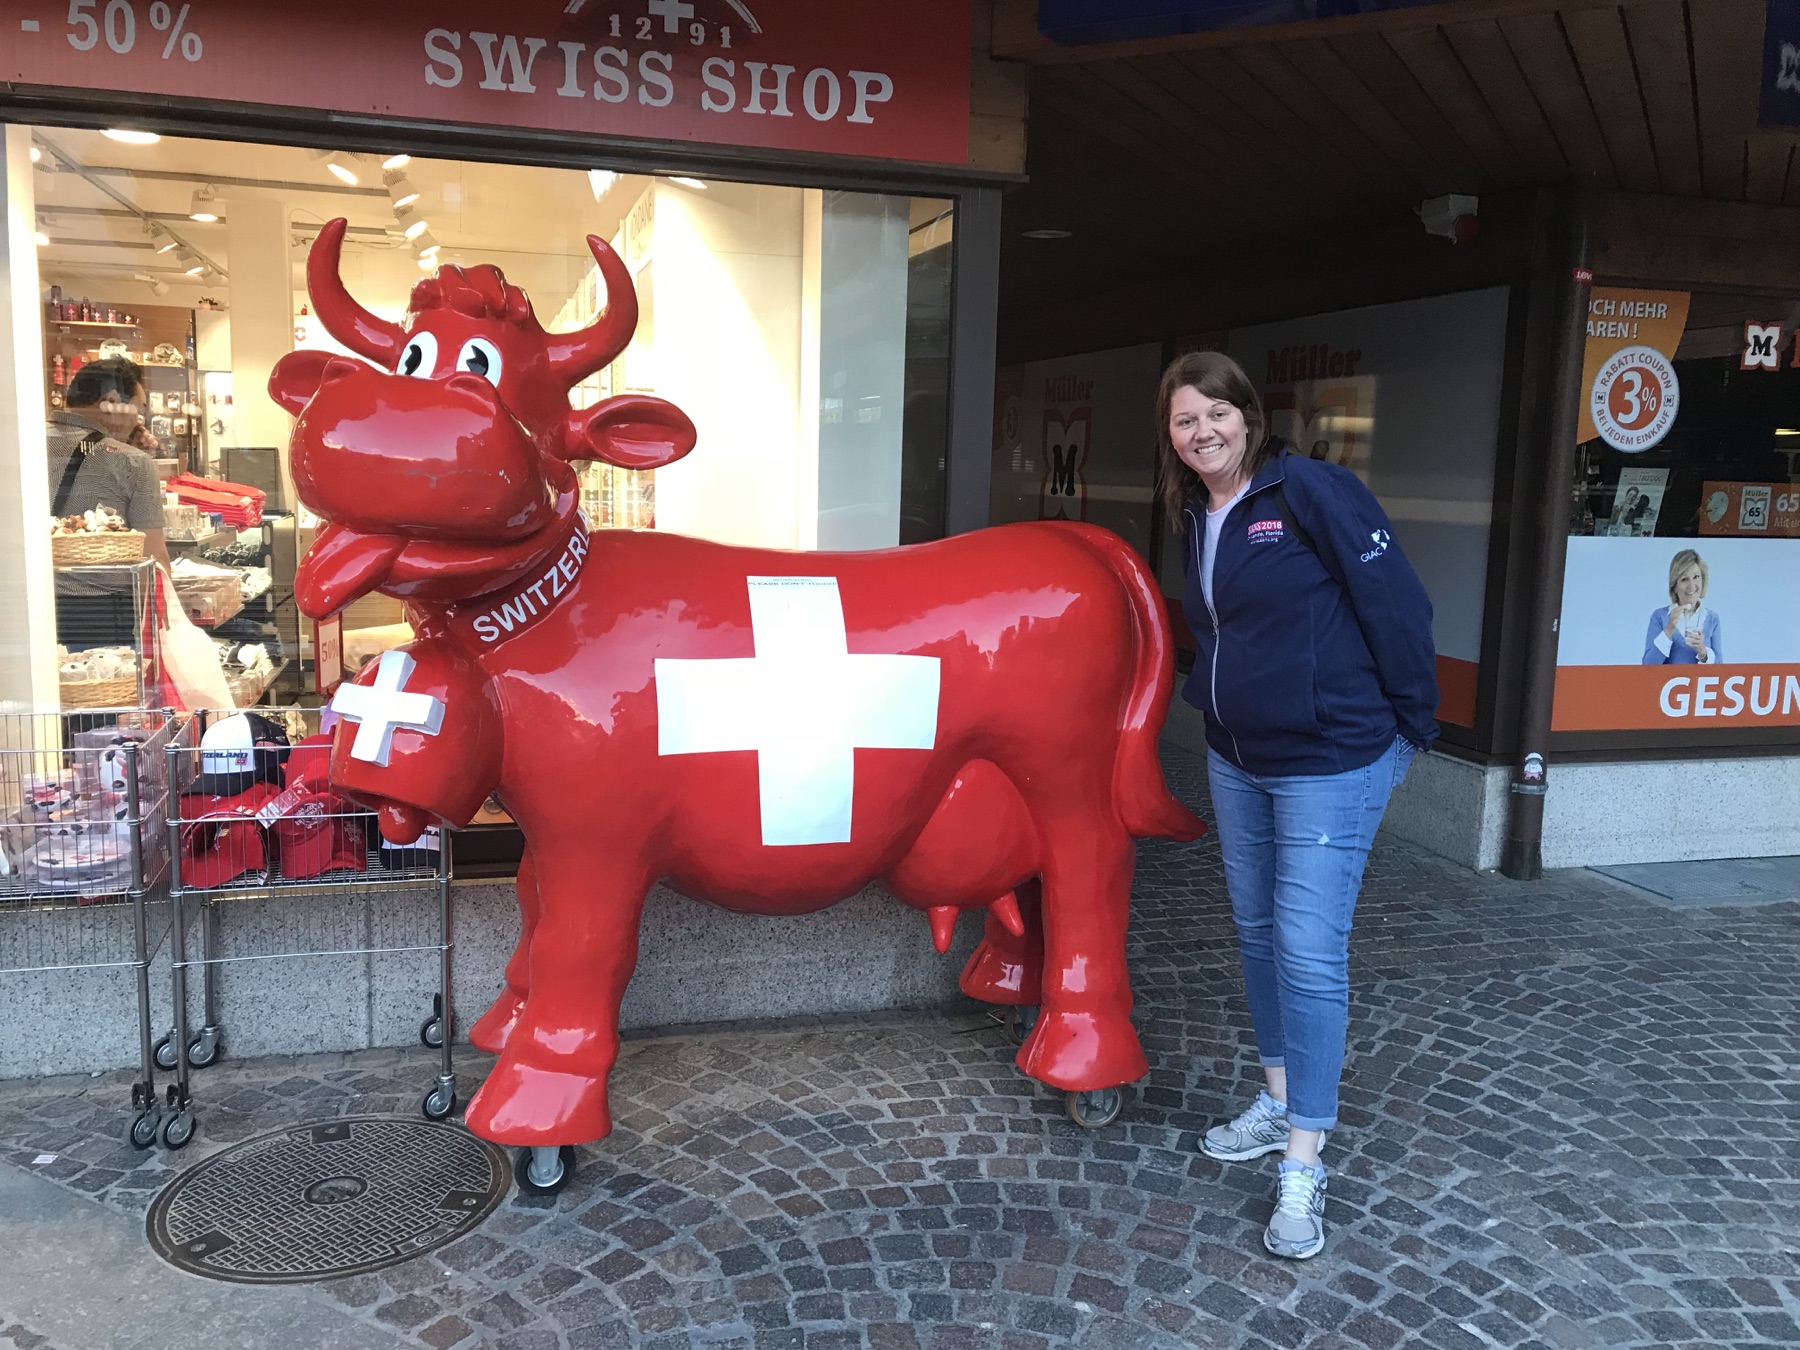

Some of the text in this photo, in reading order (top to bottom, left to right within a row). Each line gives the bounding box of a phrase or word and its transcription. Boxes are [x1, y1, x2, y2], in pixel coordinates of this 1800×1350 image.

[424, 28, 894, 124] SWISS SHOP
[1619, 300, 1668, 319] MEHR
[1266, 343, 1362, 384] Müller
[1601, 353, 1673, 389] RABATT COUPON
[1045, 375, 1094, 403] Müller
[1597, 408, 1670, 445] BEI JEDEM EINKAUF
[1261, 521, 1282, 530] 2018
[1748, 507, 1761, 517] 65
[1360, 547, 1383, 562] GIAC
